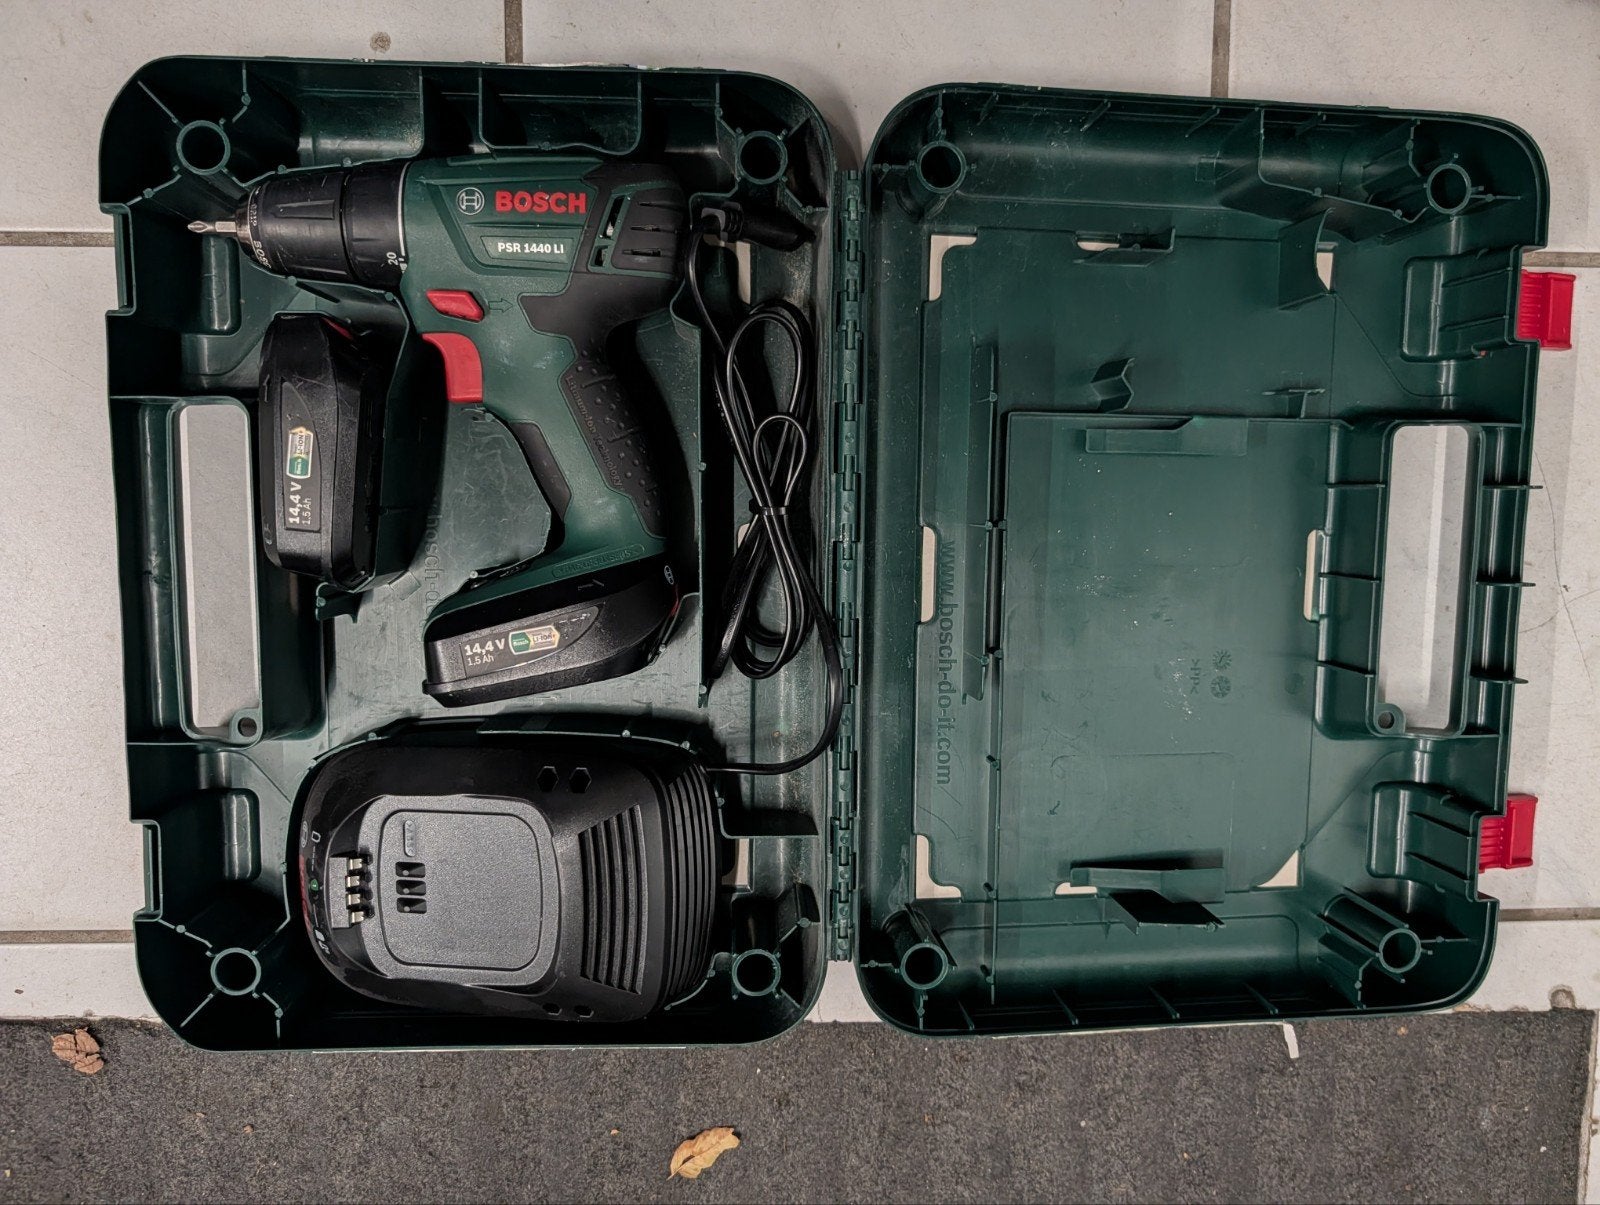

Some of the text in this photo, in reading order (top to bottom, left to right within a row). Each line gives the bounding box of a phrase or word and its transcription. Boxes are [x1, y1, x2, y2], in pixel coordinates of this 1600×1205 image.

[495, 190, 586, 214] BOSCH
[498, 242, 564, 254] PSR 1440 LI
[386, 251, 399, 266] 20
[289, 482, 303, 525] 14,4 V
[302, 498, 312, 511] Ah
[464, 638, 506, 656] 14,4 V
[482, 653, 495, 665] Ah
[936, 540, 958, 785] www.bosch-do-it.com
